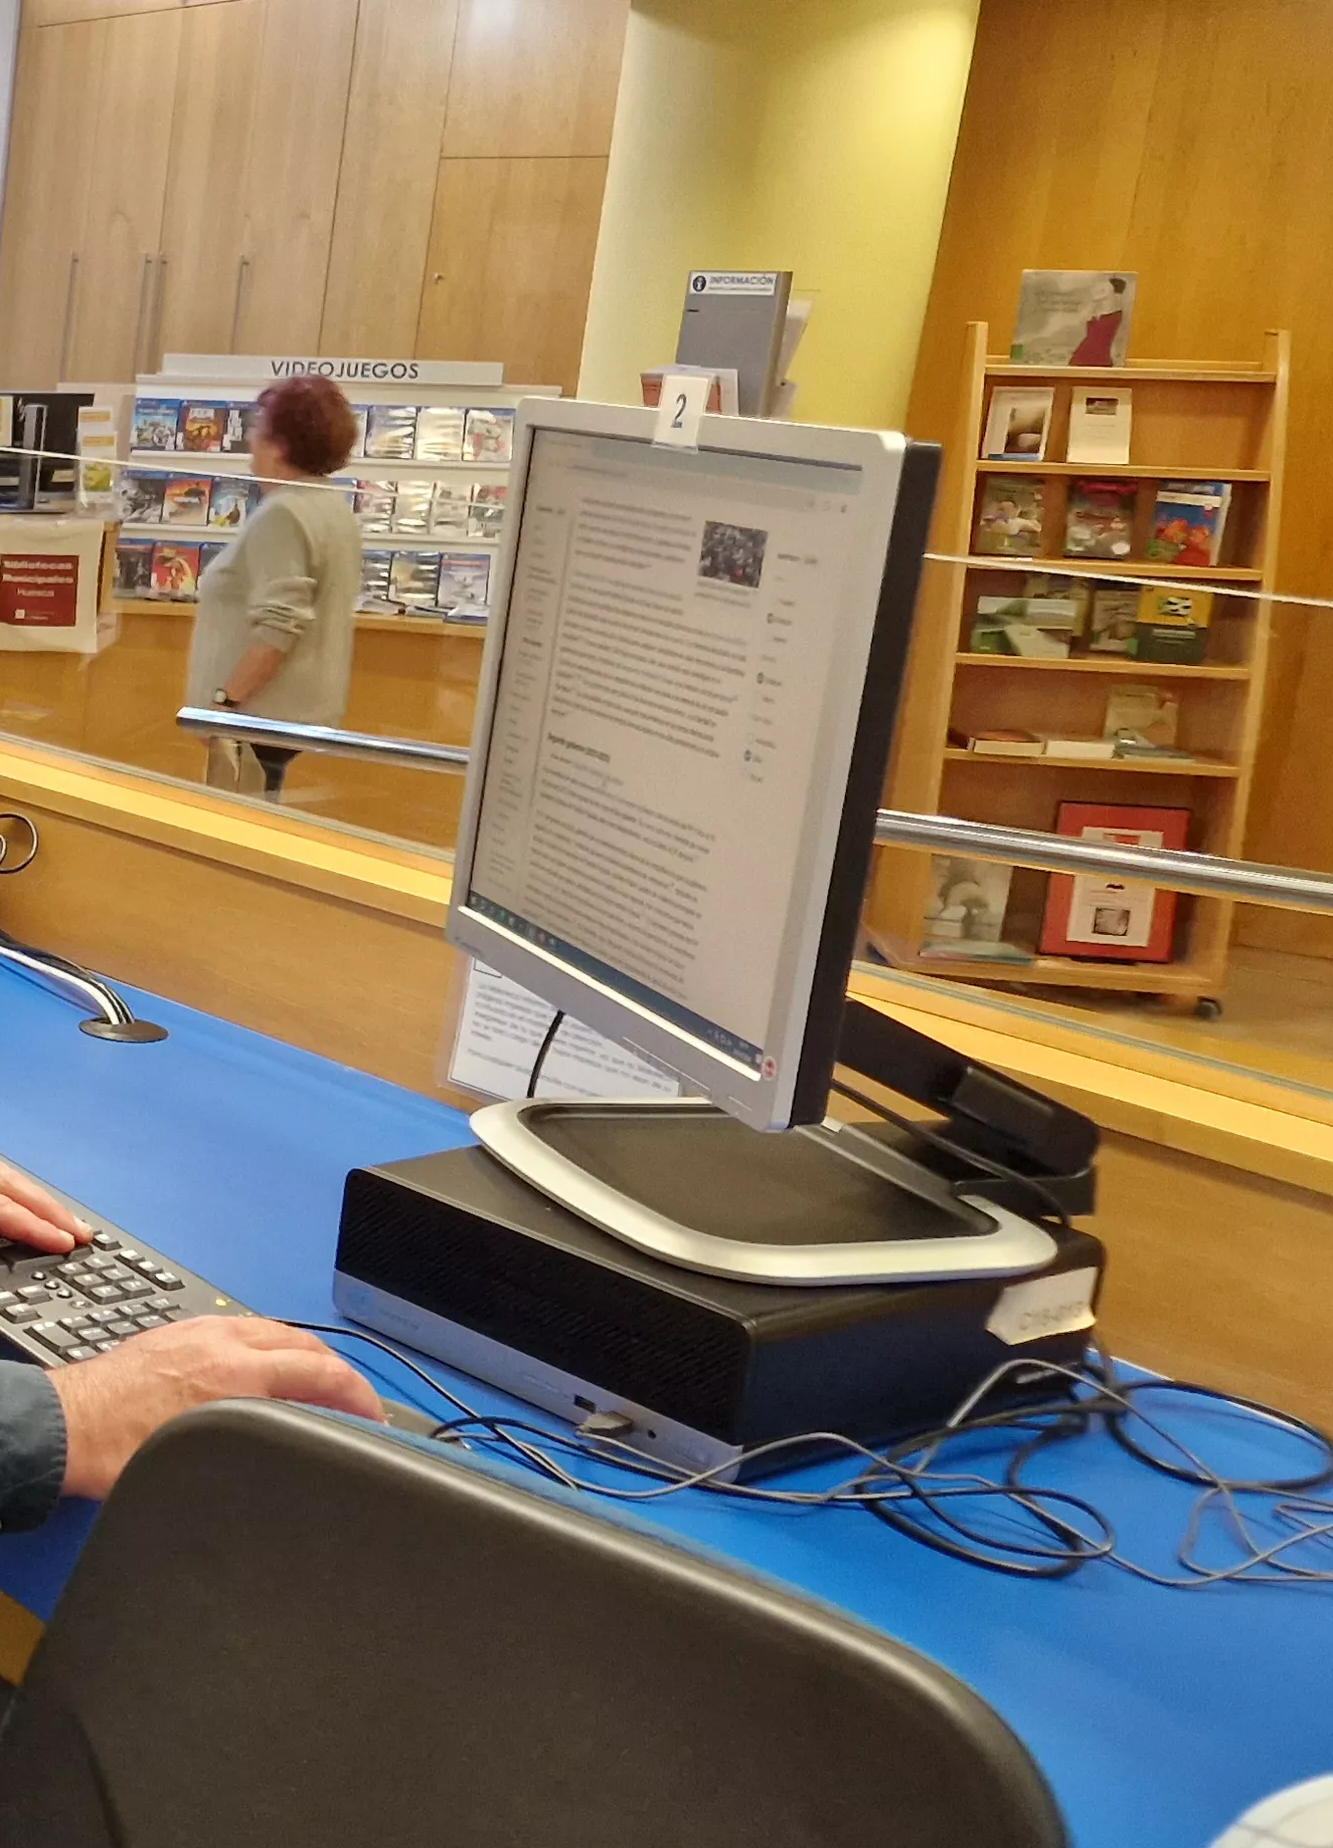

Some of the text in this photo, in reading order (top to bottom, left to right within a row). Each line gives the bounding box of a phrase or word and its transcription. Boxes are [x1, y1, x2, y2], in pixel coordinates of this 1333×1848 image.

[709, 274, 774, 285] INFORMACIÓN
[271, 360, 419, 380] VIDEOJUEGOS
[670, 393, 687, 428] 2
